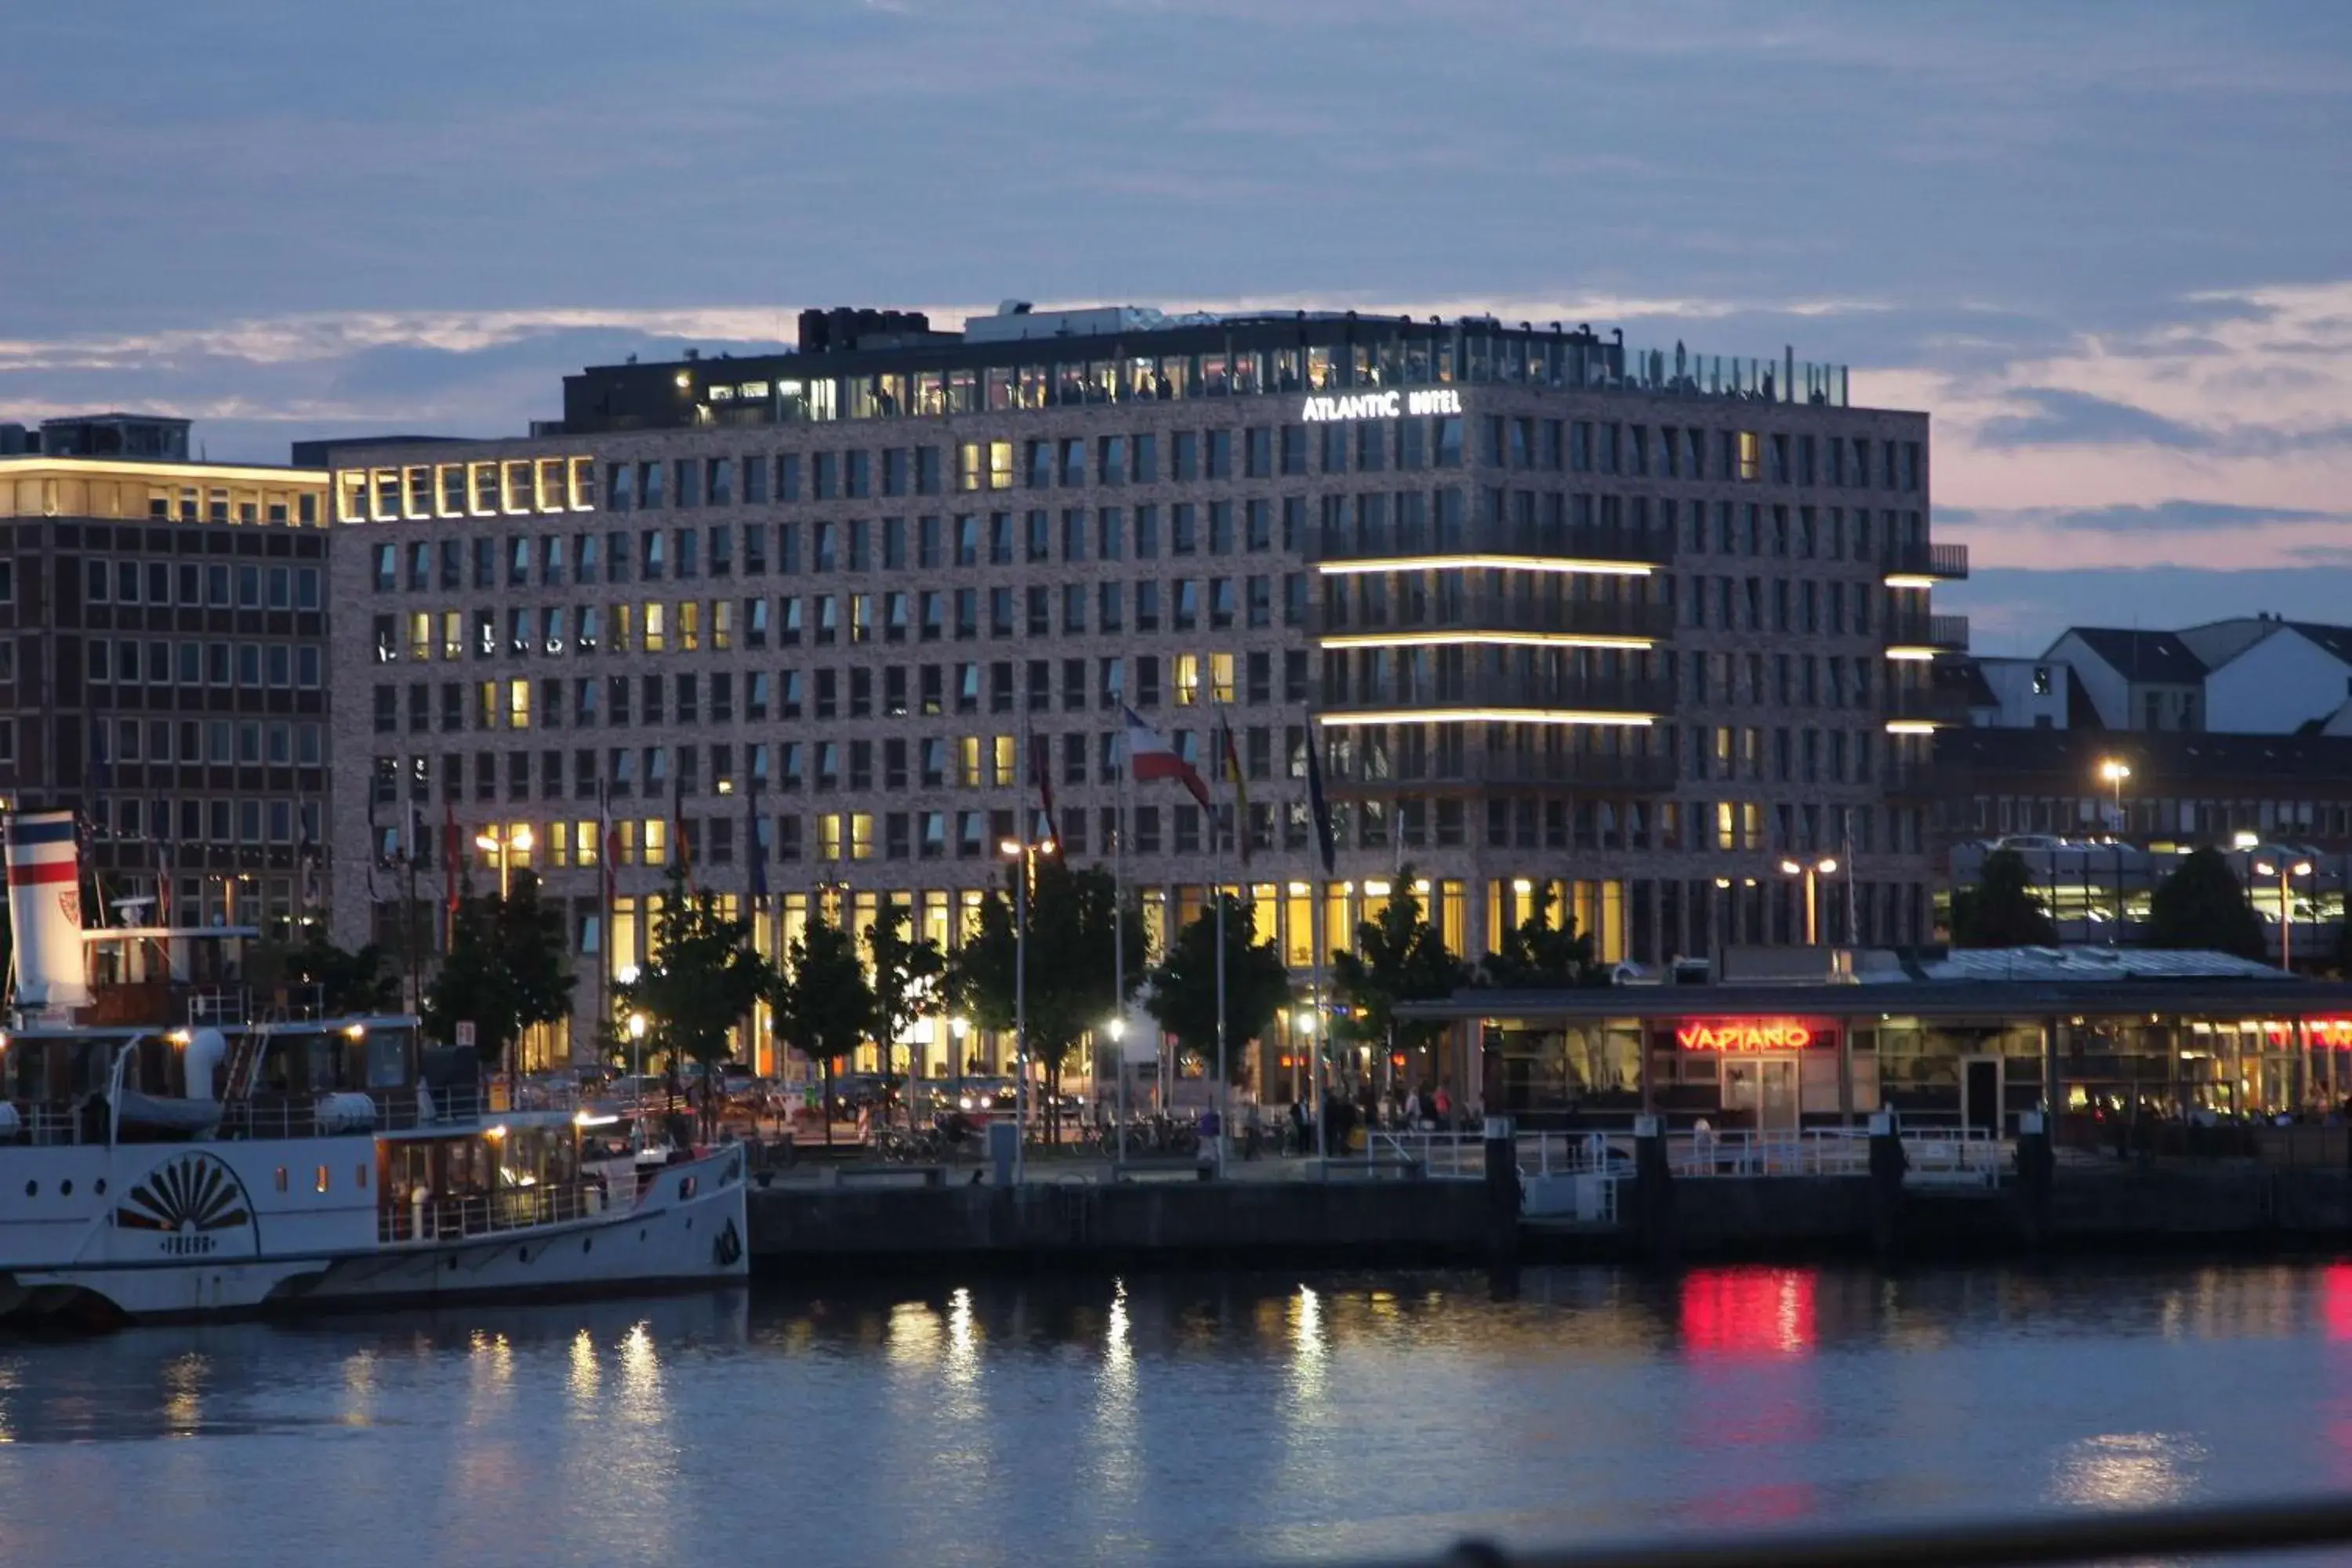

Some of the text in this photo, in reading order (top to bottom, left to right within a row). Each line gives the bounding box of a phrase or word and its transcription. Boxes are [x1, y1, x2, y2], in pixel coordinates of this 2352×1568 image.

[1302, 390, 1462, 421] ATLANTIC HOTEL
[1678, 1022, 1810, 1051] VAPIANO
